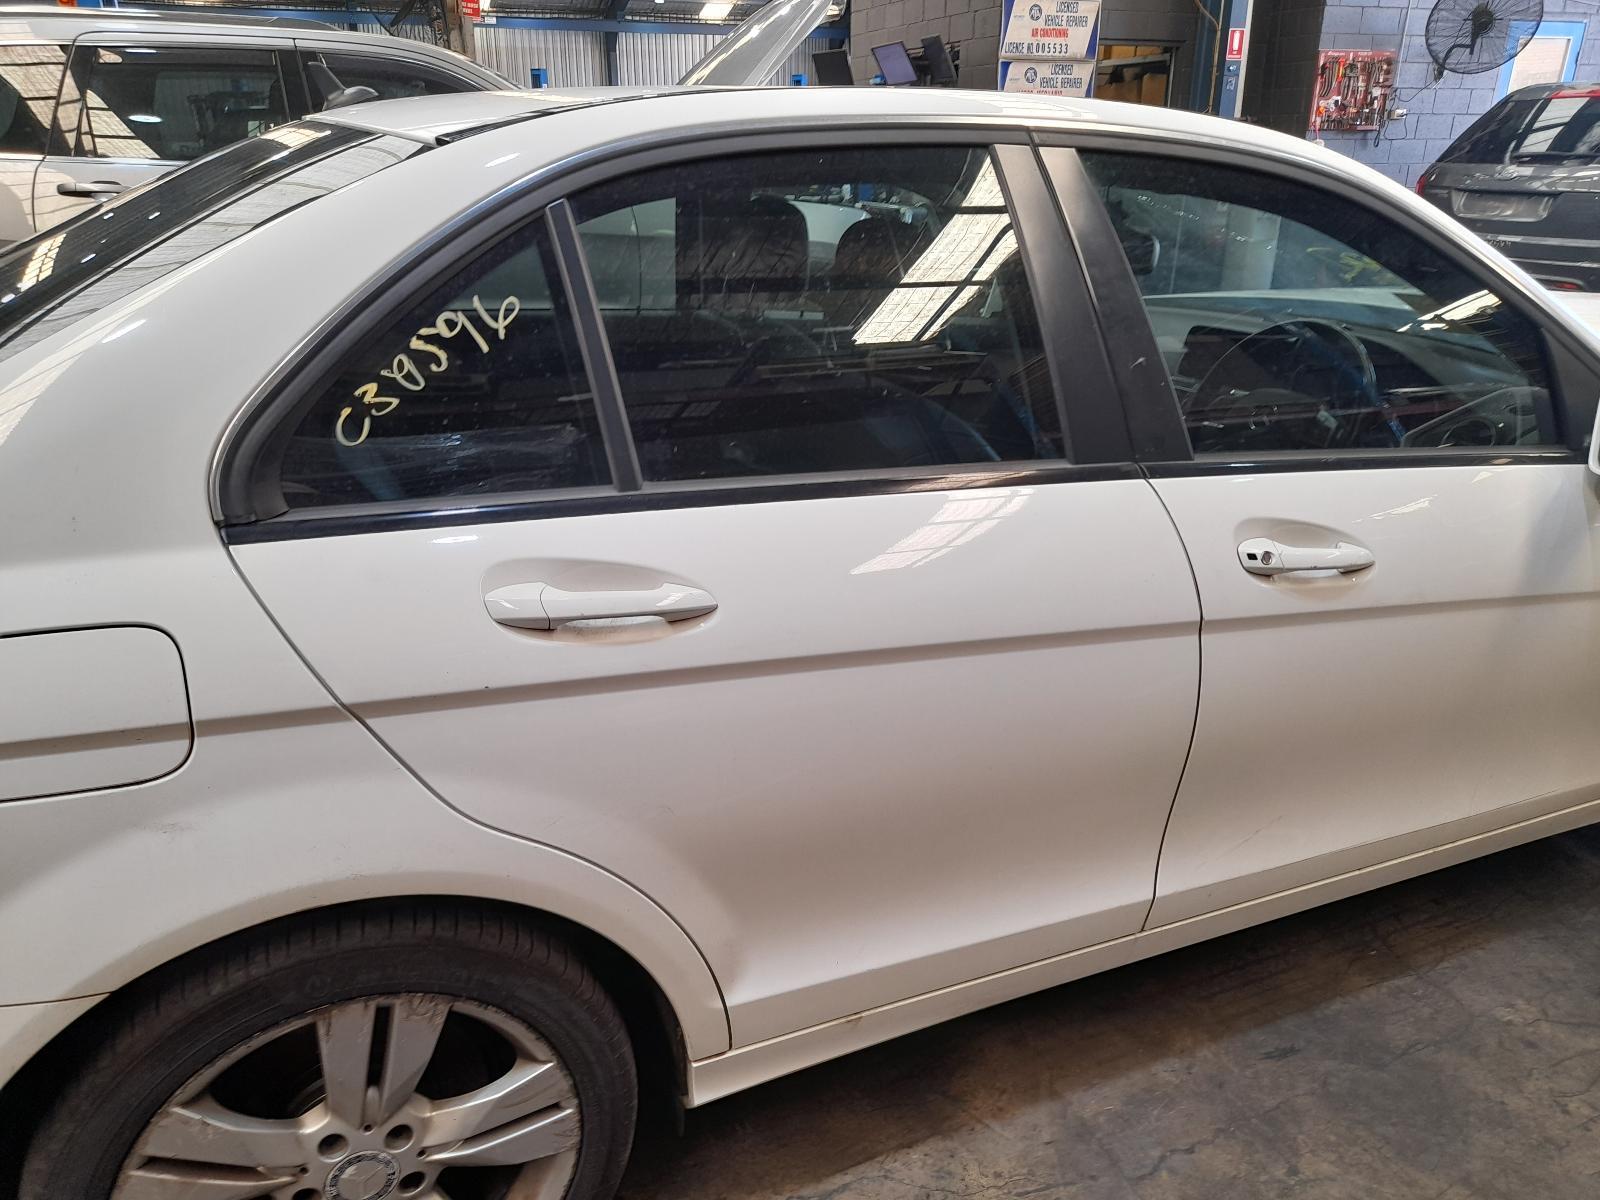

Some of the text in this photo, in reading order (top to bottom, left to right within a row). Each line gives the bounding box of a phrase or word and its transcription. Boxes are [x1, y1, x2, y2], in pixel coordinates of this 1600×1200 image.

[1045, 15, 1088, 27] VEHICLE REPAIRER
[1035, 43, 1068, 54] 005533
[1051, 64, 1073, 75] LICENSED
[1039, 77, 1082, 89] VEHICLE REPAIRER
